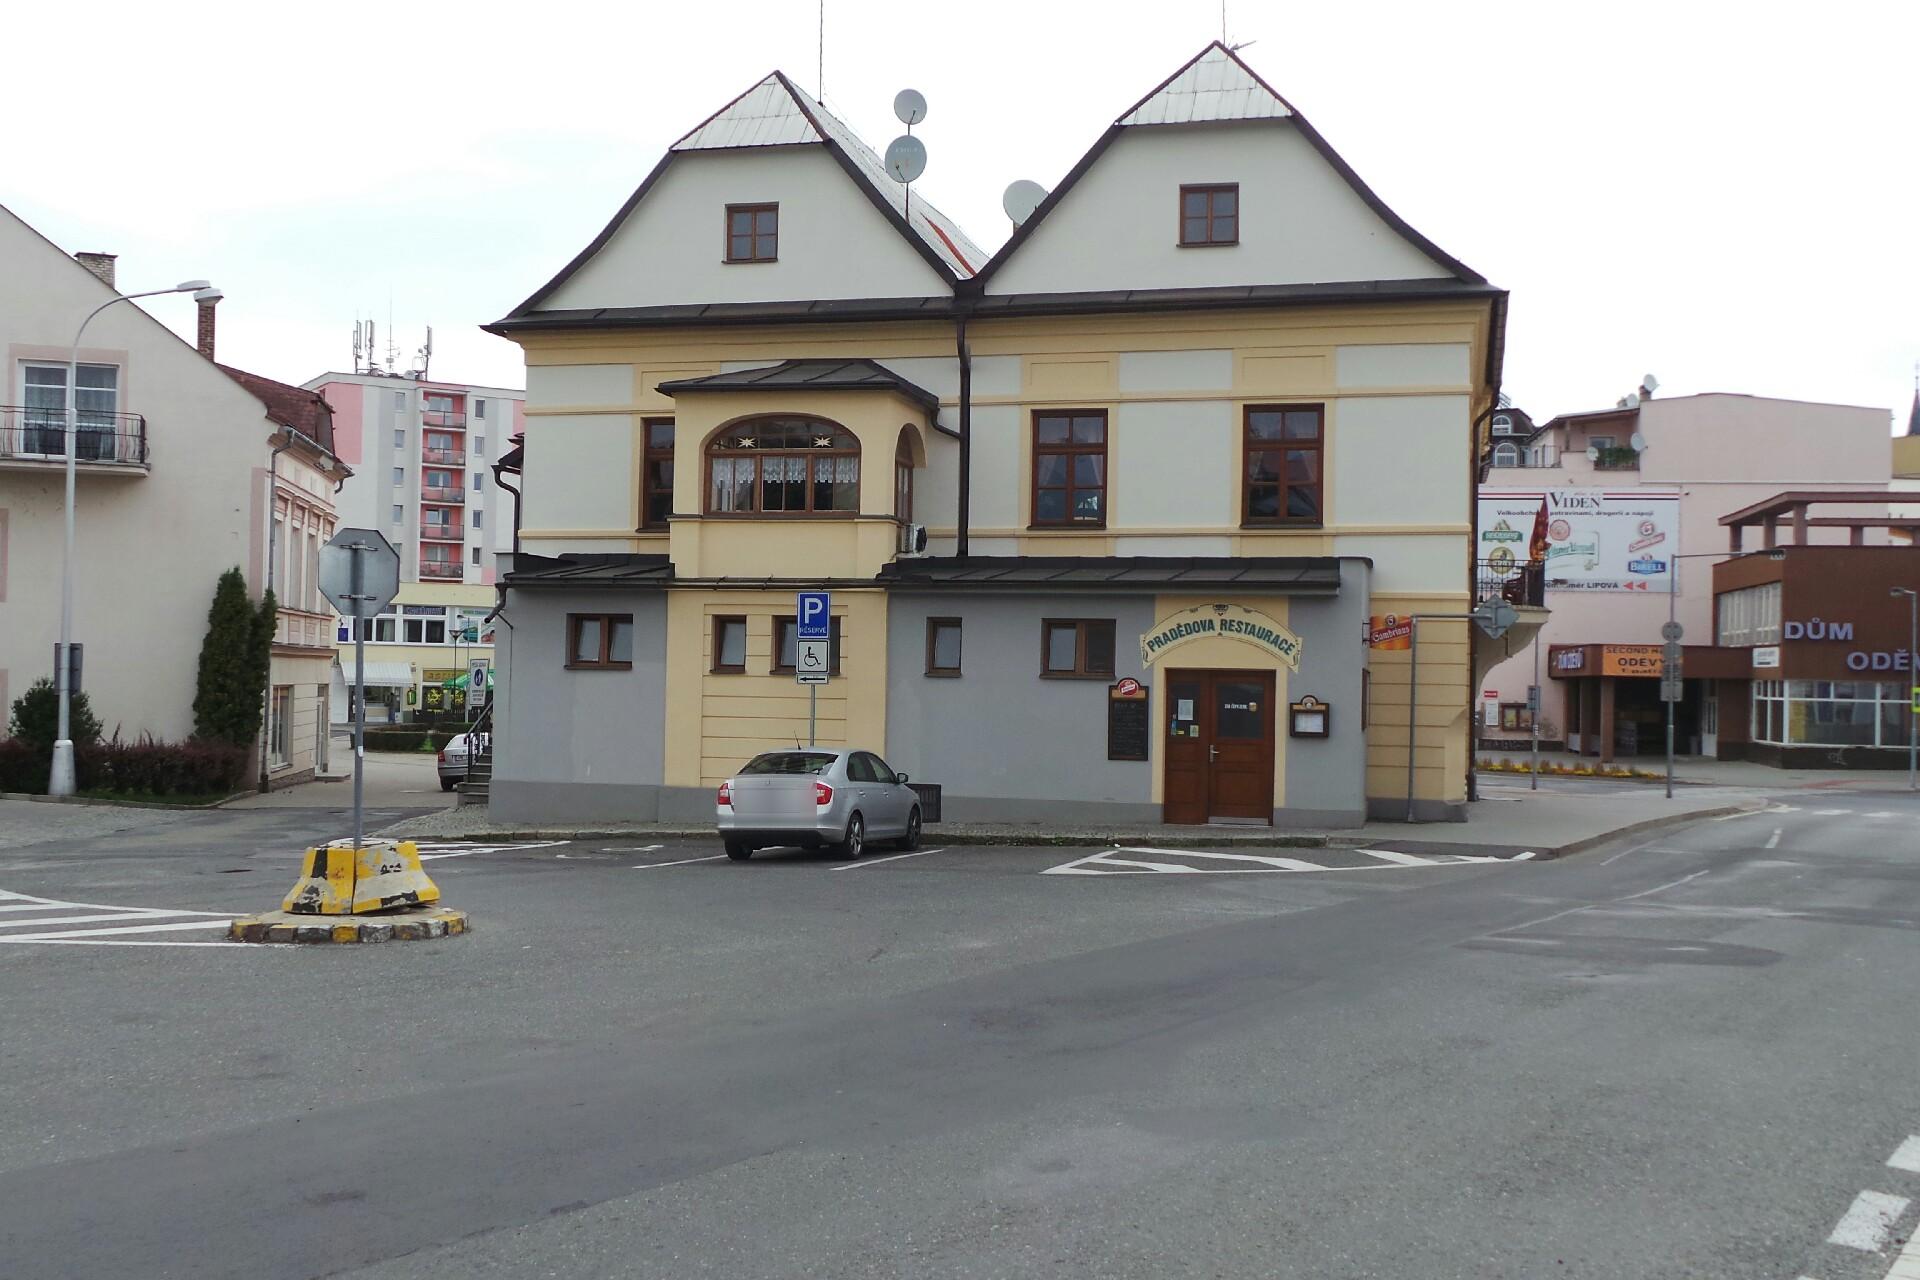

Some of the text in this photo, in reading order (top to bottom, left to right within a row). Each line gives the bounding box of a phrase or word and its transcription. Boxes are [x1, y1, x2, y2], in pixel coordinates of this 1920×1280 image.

[1549, 491, 1600, 509] VIDEN
[804, 597, 823, 625] P
[1147, 618, 1296, 656] PRADĚDOVA RESTAURACE
[1372, 626, 1410, 642] Gambrinus
[1784, 617, 1853, 641] DŮM
